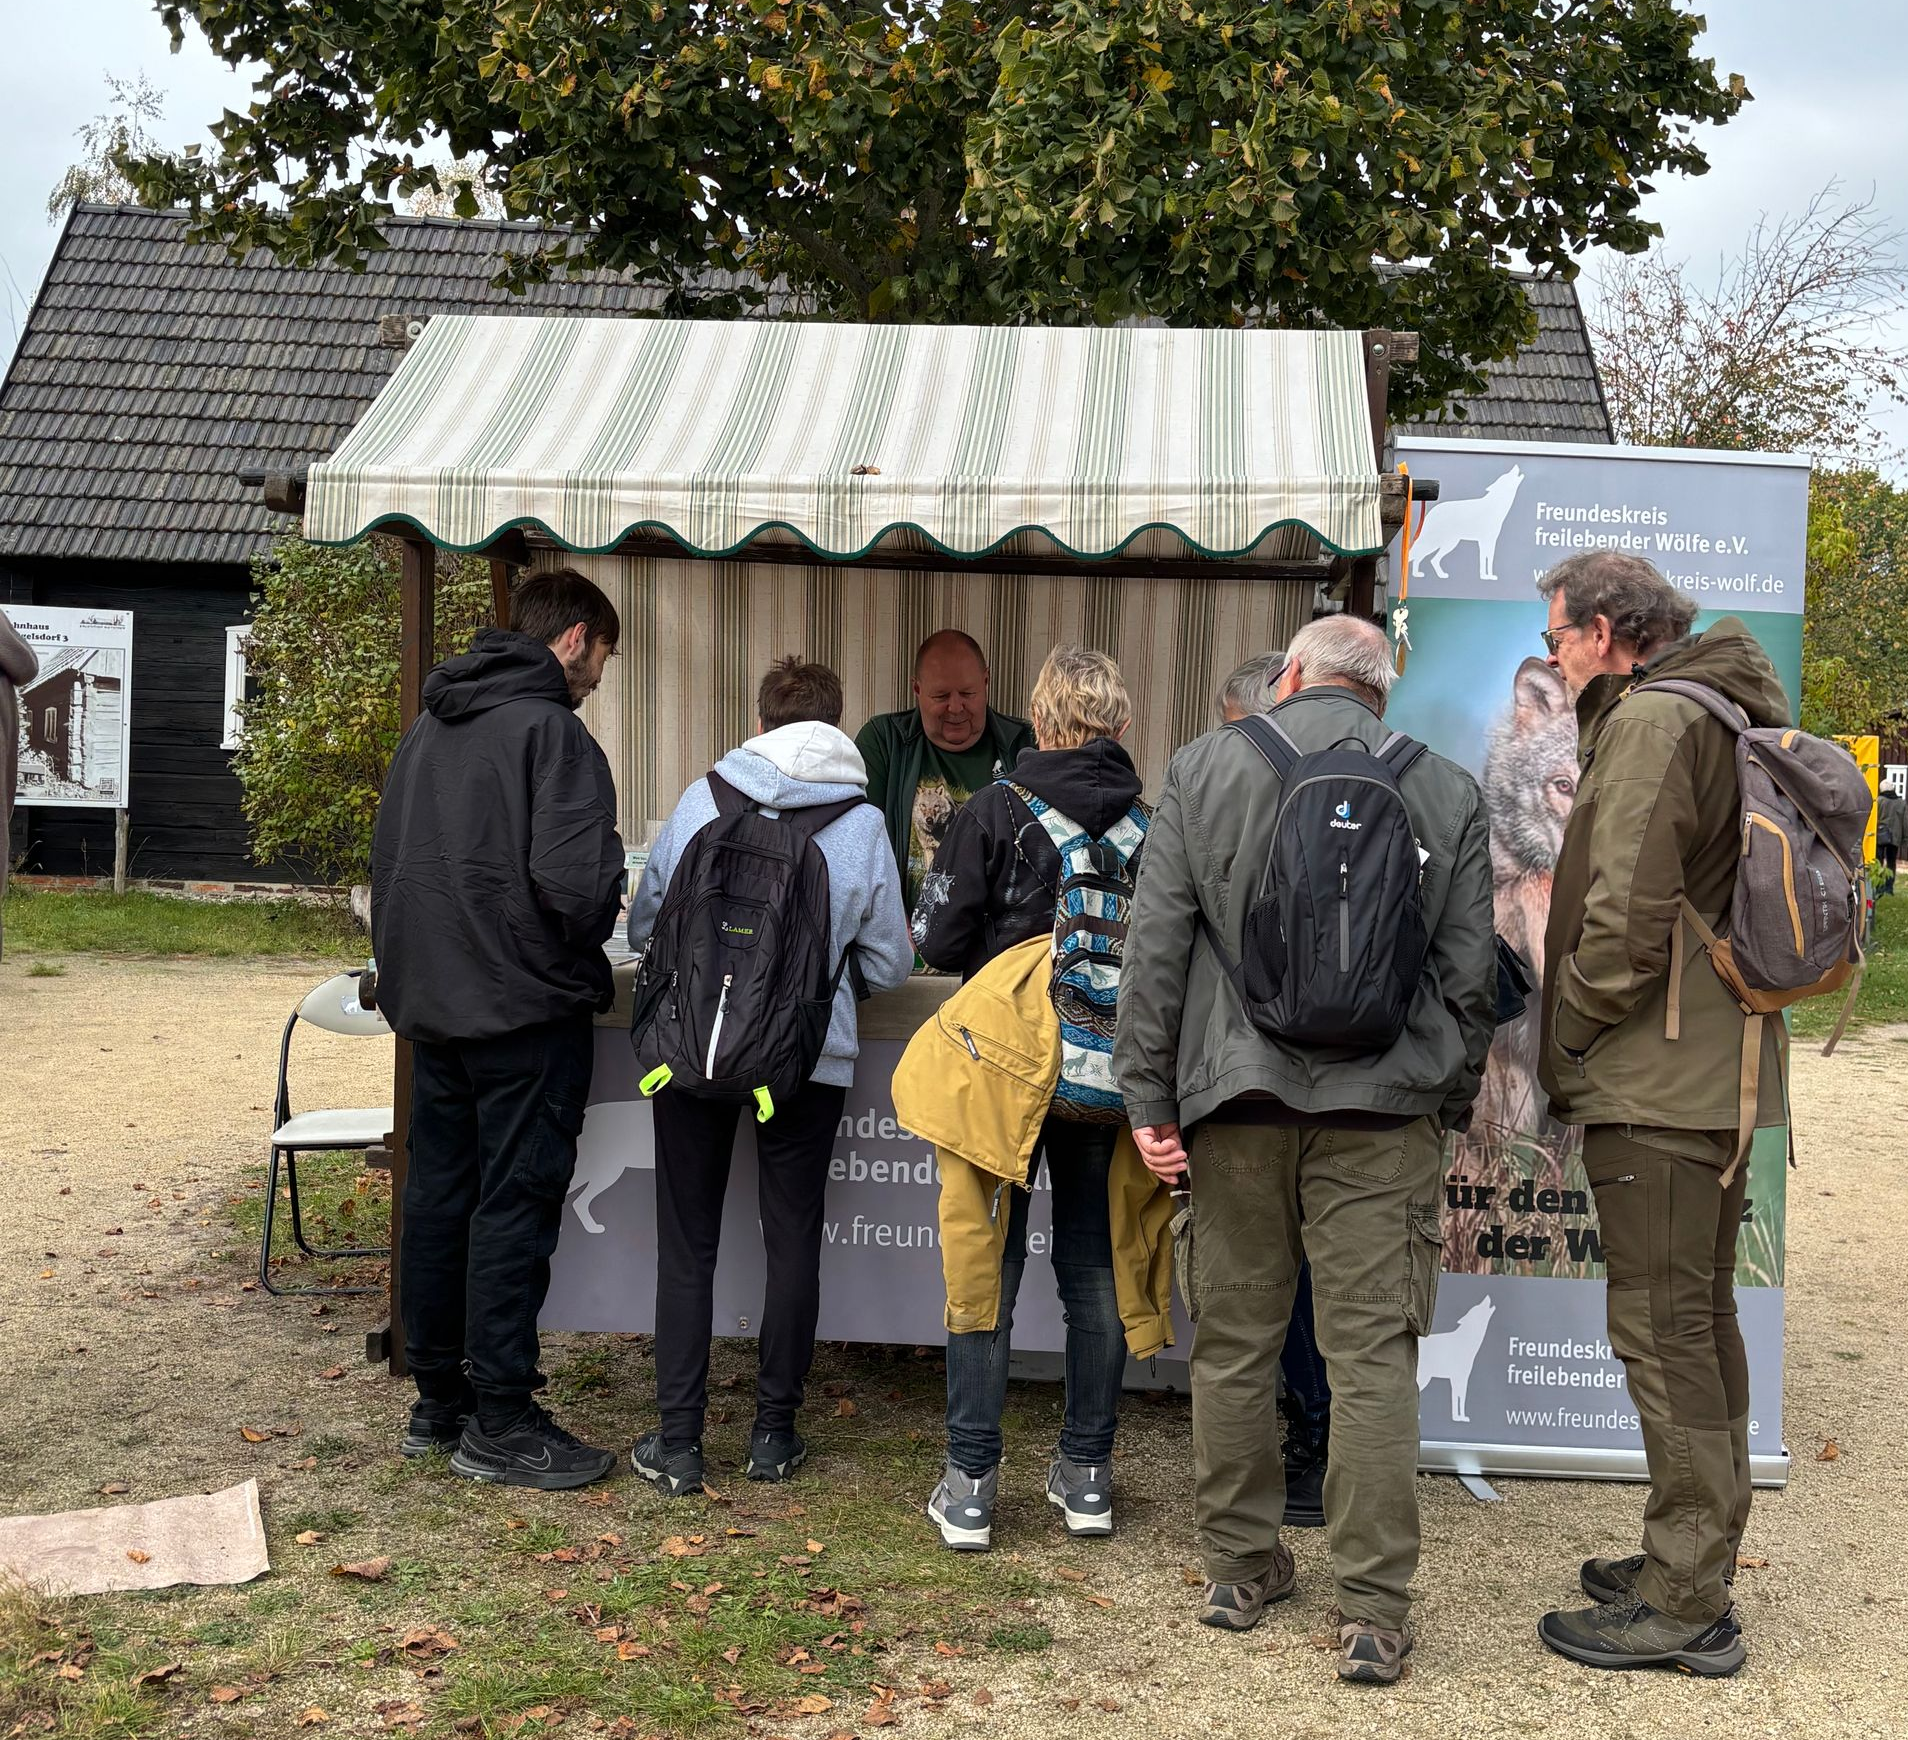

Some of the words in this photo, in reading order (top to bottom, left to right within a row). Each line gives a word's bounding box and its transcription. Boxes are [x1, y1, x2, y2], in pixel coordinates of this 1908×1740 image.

[1536, 502, 1668, 526] Freundeskreis
[1535, 526, 1651, 550] freilebender
[1655, 532, 1710, 553] Wölfe
[1715, 535, 1749, 555] e.V.
[13, 621, 50, 630] hnhaus
[1330, 819, 1362, 830] deuter
[1443, 1174, 1496, 1210] ür
[1509, 1179, 1588, 1215] den
[1477, 1225, 1551, 1260] der
[1507, 1364, 1625, 1390] freilebender
